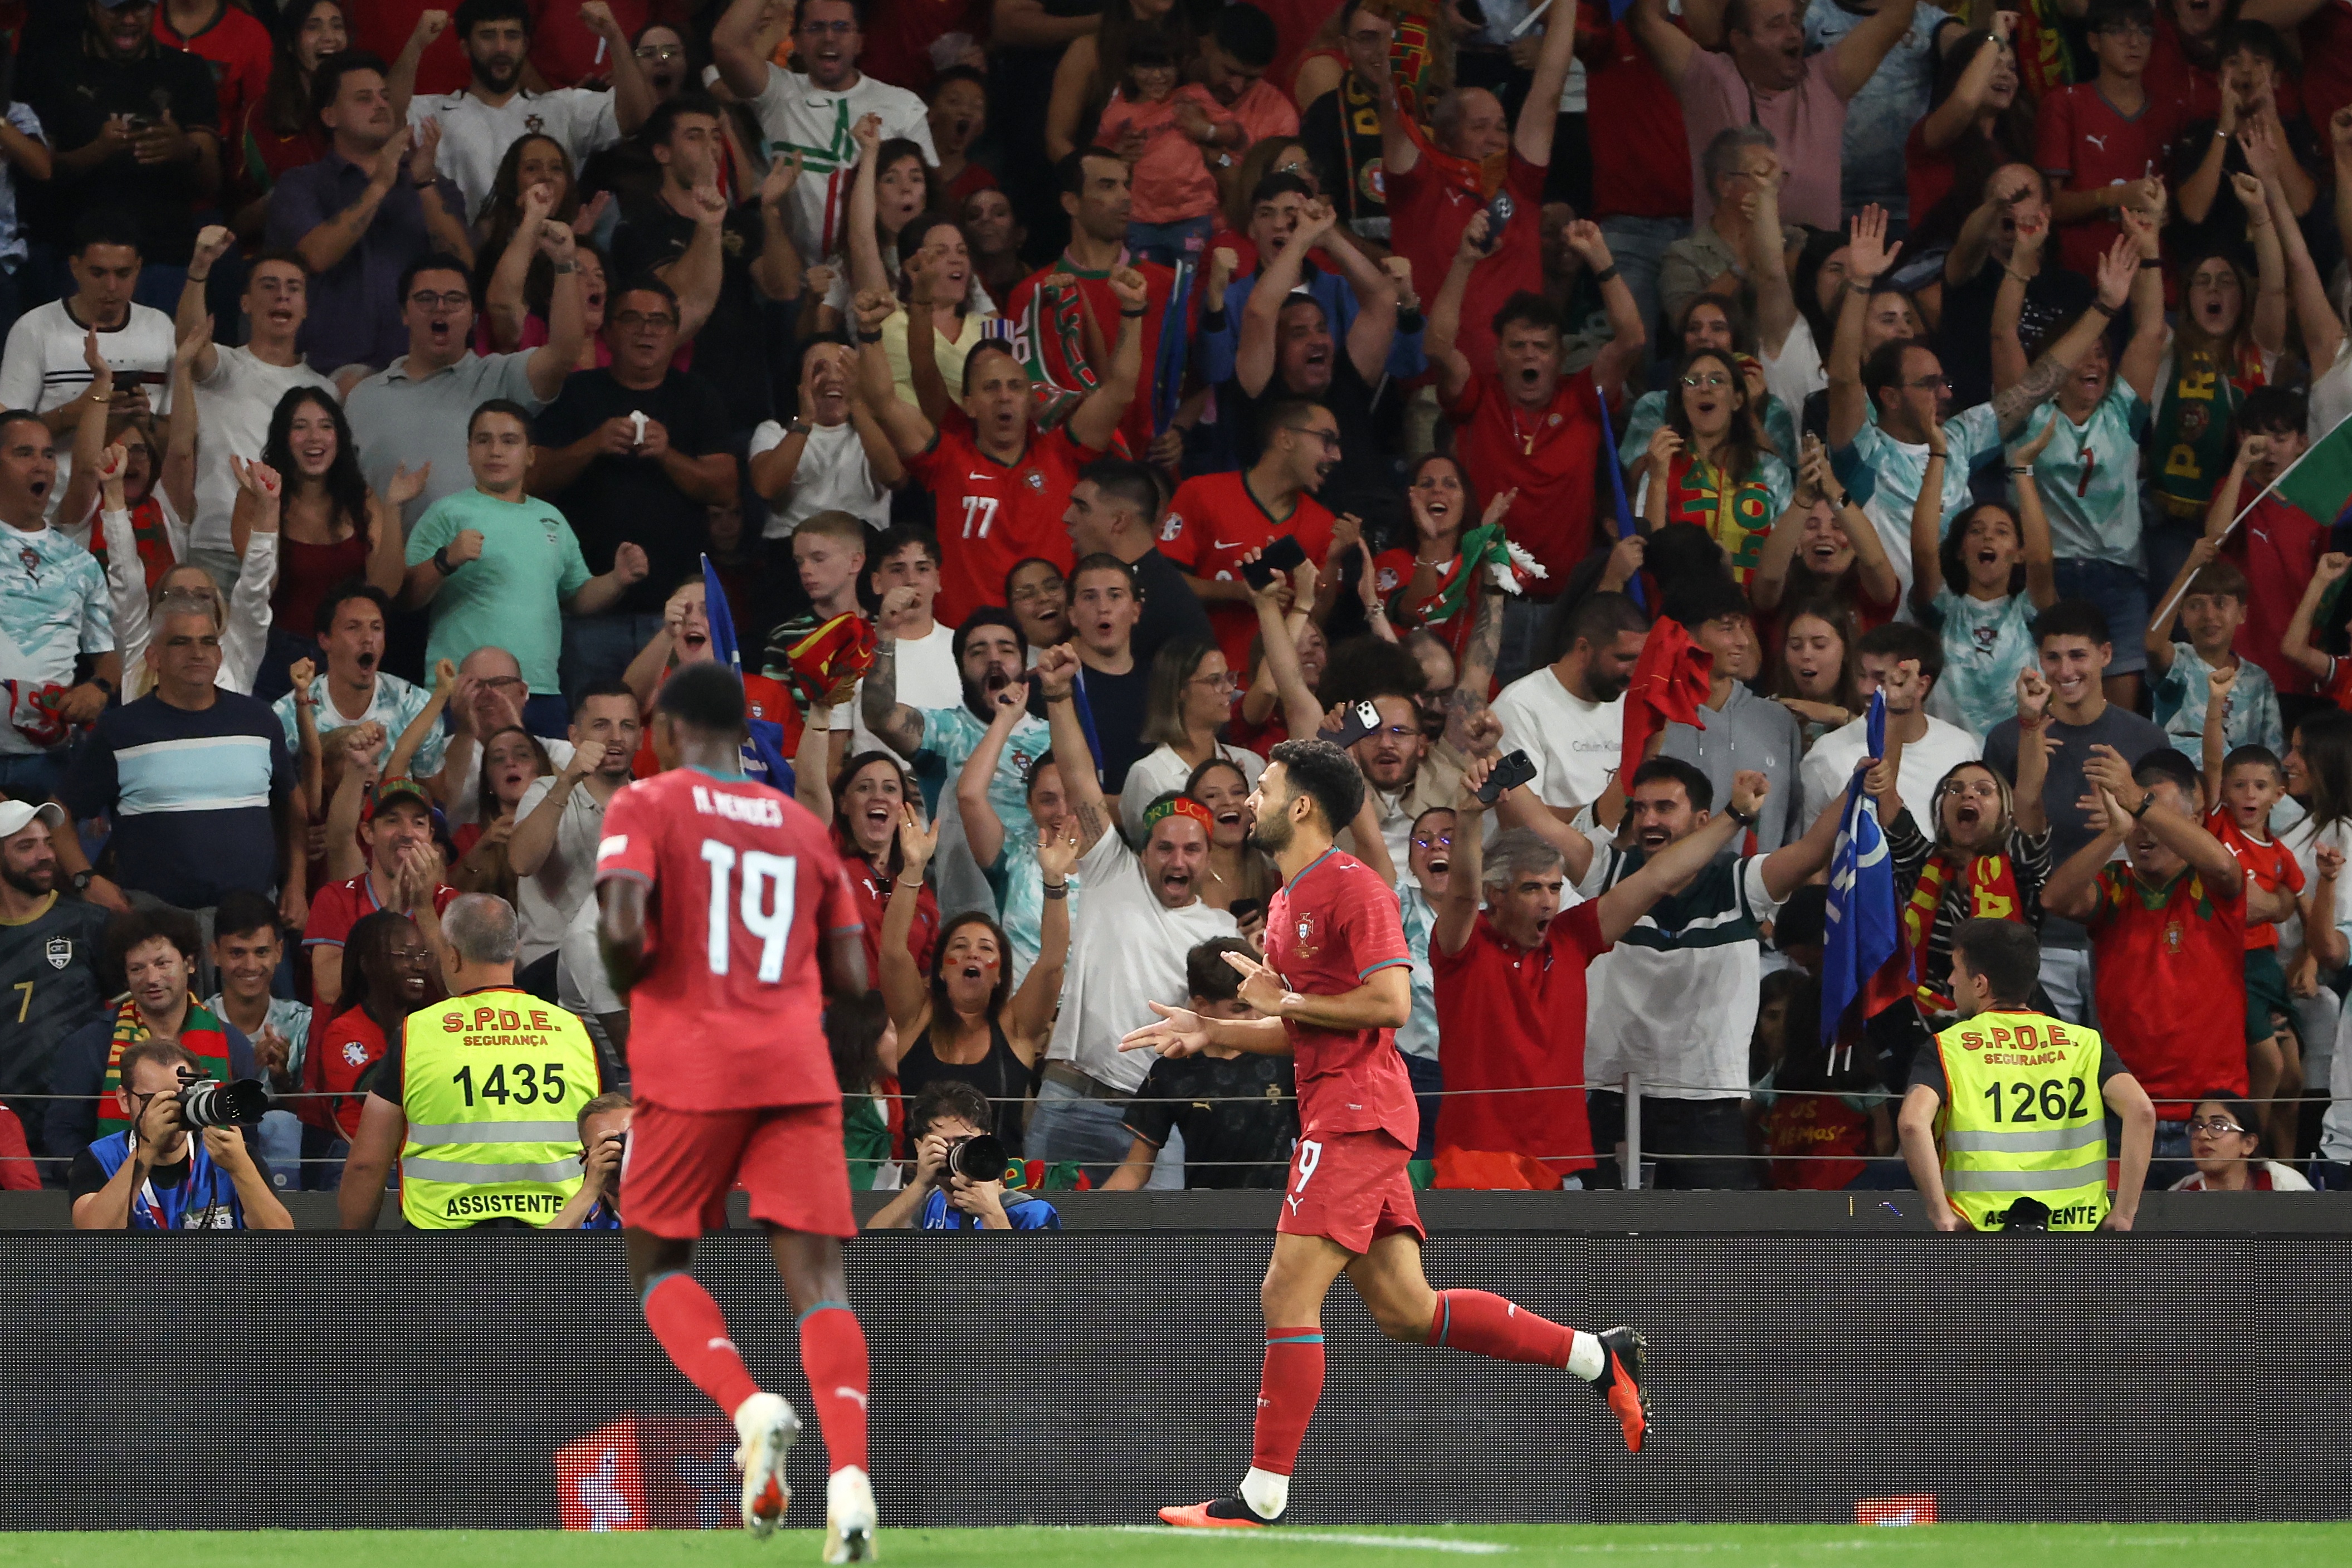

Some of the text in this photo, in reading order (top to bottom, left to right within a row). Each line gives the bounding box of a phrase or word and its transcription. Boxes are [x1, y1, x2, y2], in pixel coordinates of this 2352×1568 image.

[962, 495, 999, 539] 77
[700, 838, 798, 983] 19
[13, 980, 35, 1024] 7
[442, 1007, 562, 1033] S.P.D.E.
[1960, 1024, 2080, 1051] S.P.D.E.
[462, 1034, 549, 1047] SEGURANÇA
[1983, 1050, 2066, 1066] SEGURANÇA
[452, 1063, 566, 1107] 1435
[1984, 1076, 2088, 1124] 1262
[1295, 1139, 1323, 1193] 9
[446, 1194, 565, 1217] ASSISTENTE
[1984, 1205, 2098, 1227] ASENTE
